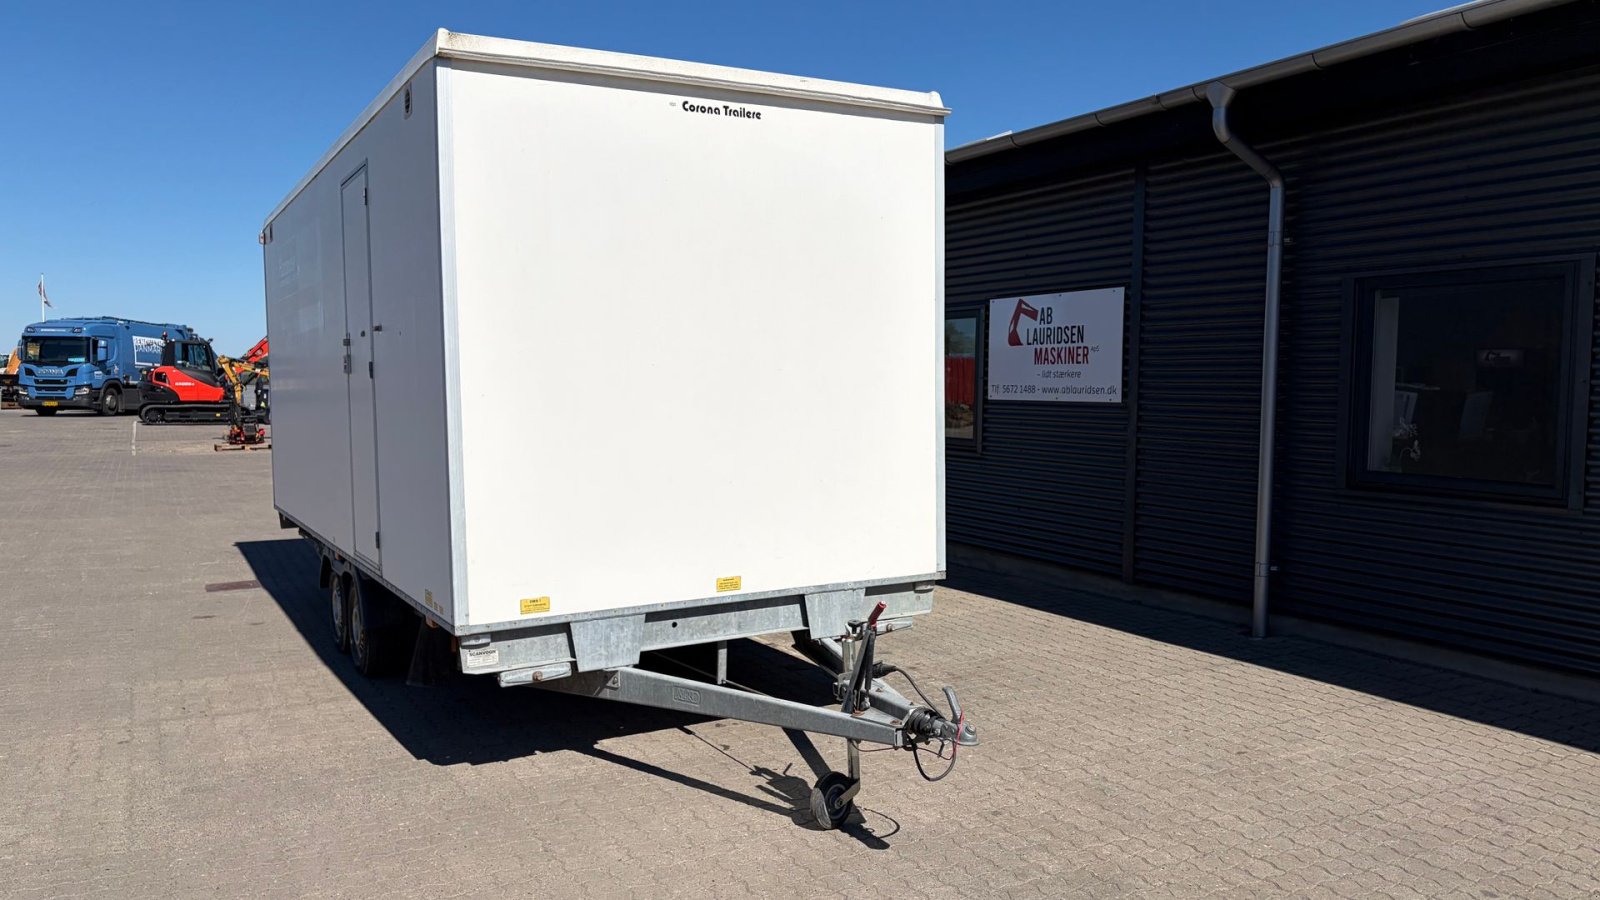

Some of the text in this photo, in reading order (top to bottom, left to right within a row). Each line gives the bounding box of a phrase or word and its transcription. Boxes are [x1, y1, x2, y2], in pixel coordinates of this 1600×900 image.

[682, 101, 762, 120] Corona Trailere
[1039, 307, 1053, 325] AB
[1026, 325, 1085, 345] LAURIDSEN
[1034, 346, 1089, 365] MASKINER
[1042, 370, 1052, 378] lidt
[1053, 370, 1081, 378] stærkere
[1002, 384, 1018, 394] 5672
[1020, 384, 1036, 394] 1488
[1042, 385, 1117, 395] www.ablauridsen.dk
